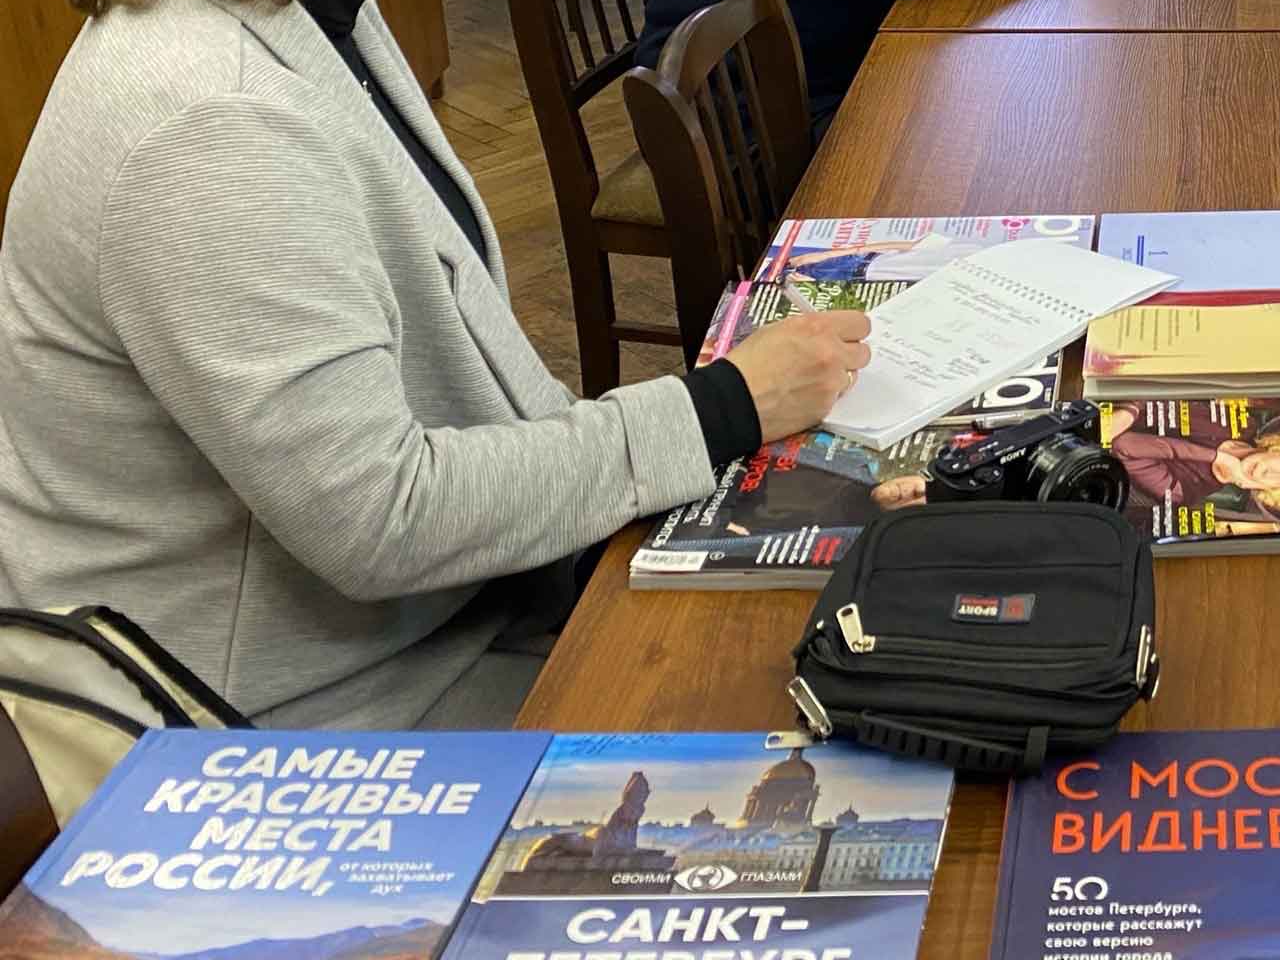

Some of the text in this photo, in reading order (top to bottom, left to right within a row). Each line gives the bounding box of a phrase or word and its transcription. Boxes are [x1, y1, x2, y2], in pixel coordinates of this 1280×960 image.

[1000, 448, 1027, 464] SONY
[957, 603, 999, 617] SPORT
[201, 746, 425, 781] САМЫЕ
[1056, 762, 1101, 801] С
[143, 780, 482, 815] КРАСИВЫЕ
[188, 818, 393, 852] МЕСТА
[60, 851, 335, 897] РОССИИ,
[611, 869, 803, 886] СВОИМИ ГЛАЗАМИ
[1051, 876, 1109, 901] 50
[1048, 901, 1203, 918] мостов Петербурга,
[566, 907, 808, 944] САНКТ-
[1046, 918, 1203, 934] которые расскажут
[1045, 936, 1154, 950] свою версию
